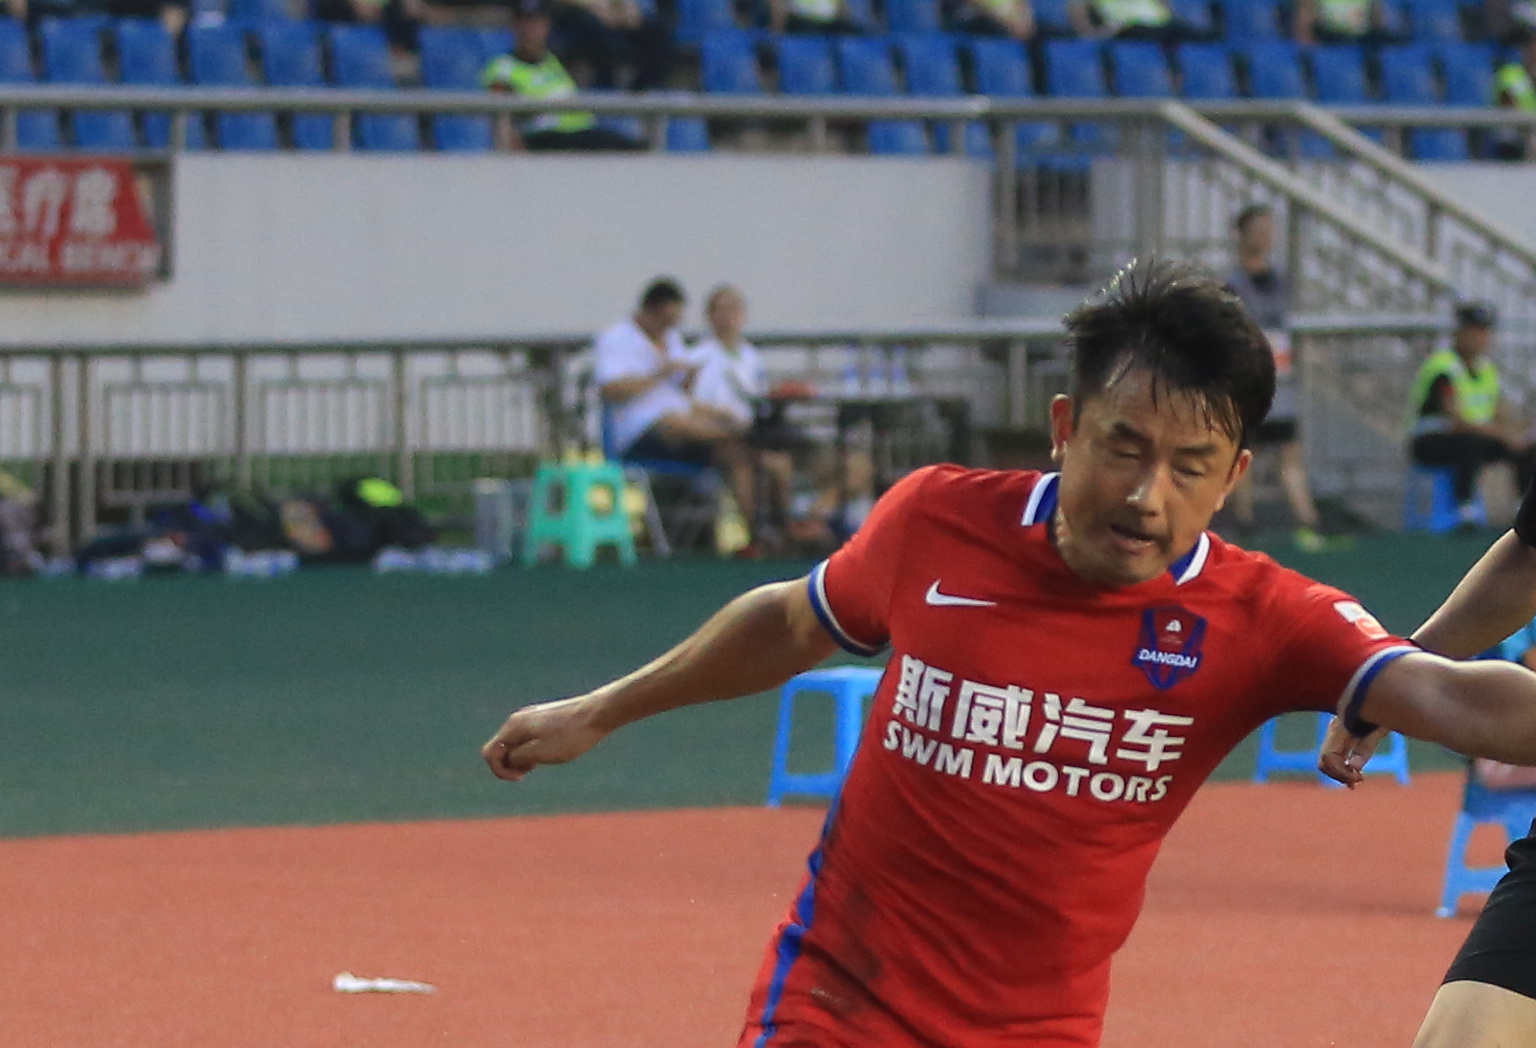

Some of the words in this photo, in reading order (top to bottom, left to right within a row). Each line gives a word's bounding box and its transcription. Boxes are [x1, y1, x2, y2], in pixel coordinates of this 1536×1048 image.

[1138, 648, 1198, 669] DANGDAI
[893, 654, 1194, 772] 斯威汽车
[883, 720, 975, 779] SWM
[981, 753, 1174, 803] MOTORS
